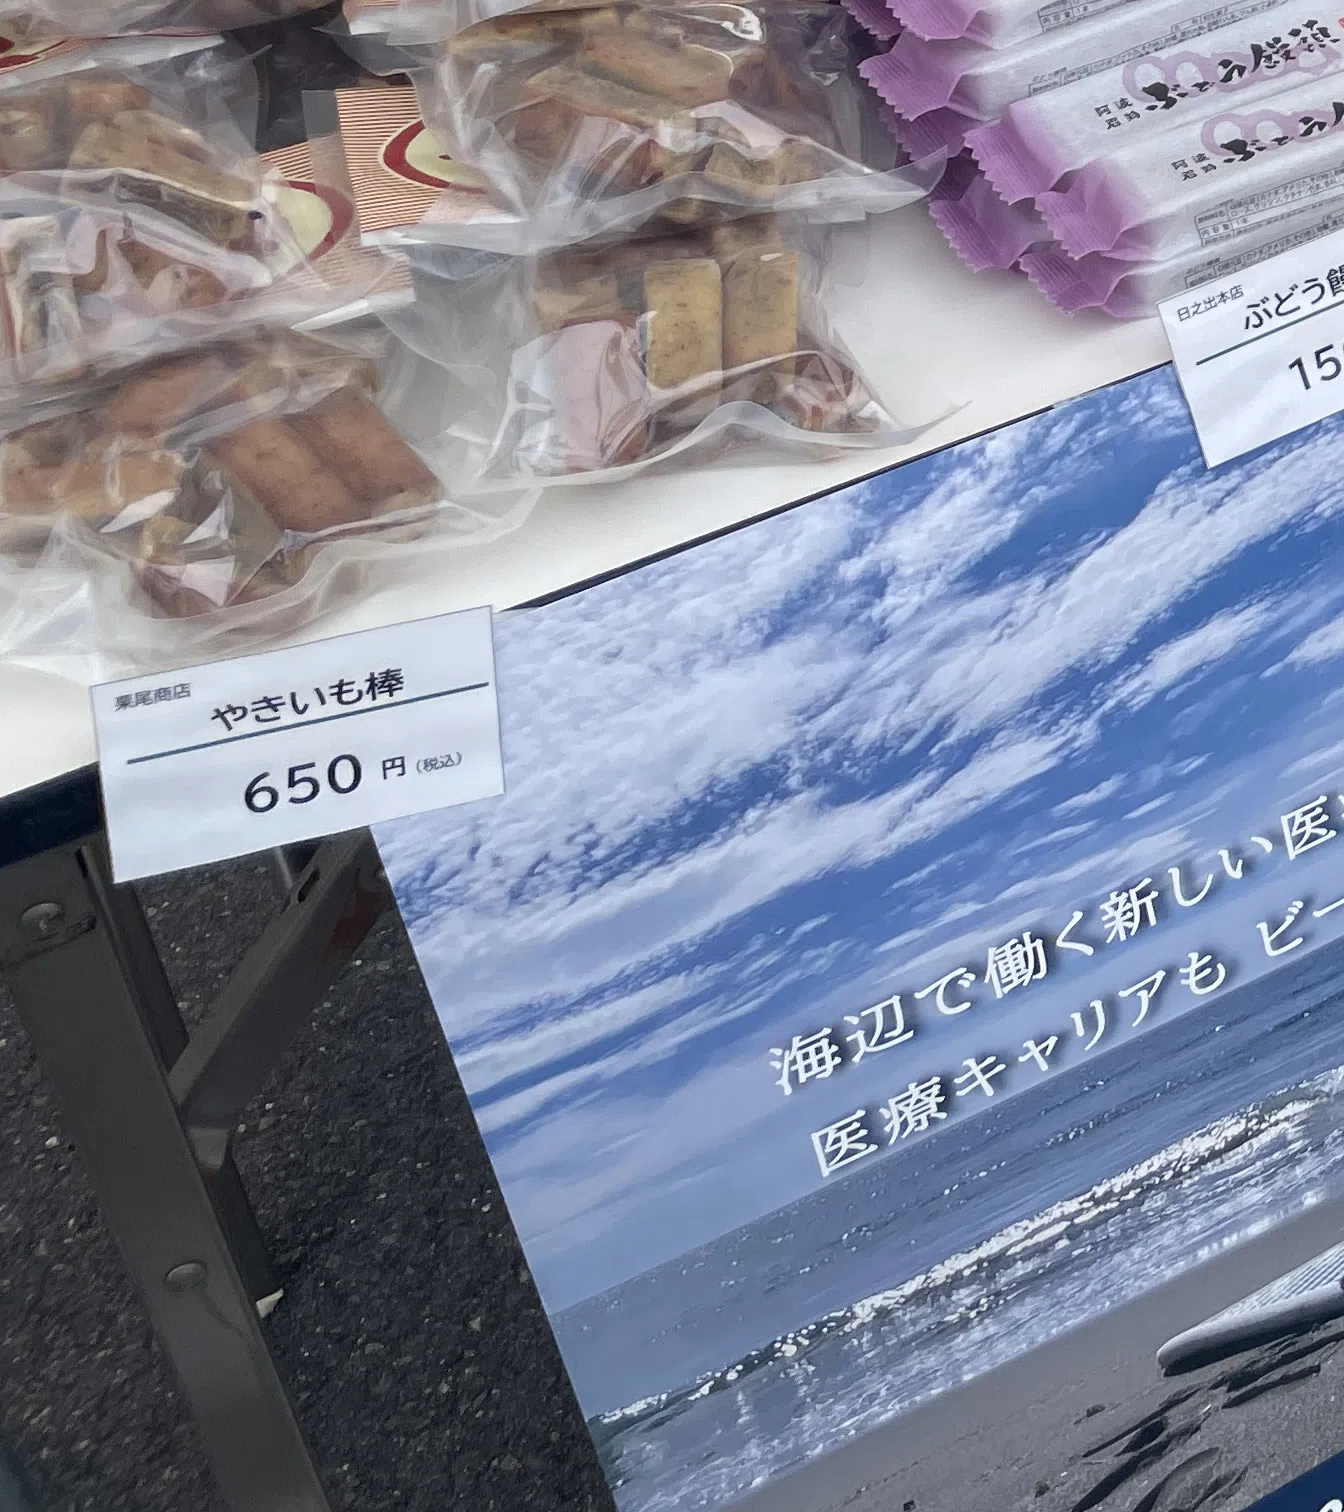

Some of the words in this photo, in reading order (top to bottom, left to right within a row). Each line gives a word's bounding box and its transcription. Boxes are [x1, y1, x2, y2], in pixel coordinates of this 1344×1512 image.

[1177, 284, 1245, 322] 日之出本店
[210, 669, 405, 731] やきいも棒
[243, 753, 363, 814] 650
[381, 756, 406, 781] 円
[416, 751, 463, 775] (税込)
[809, 950, 1228, 1179] 医療キャリアも
